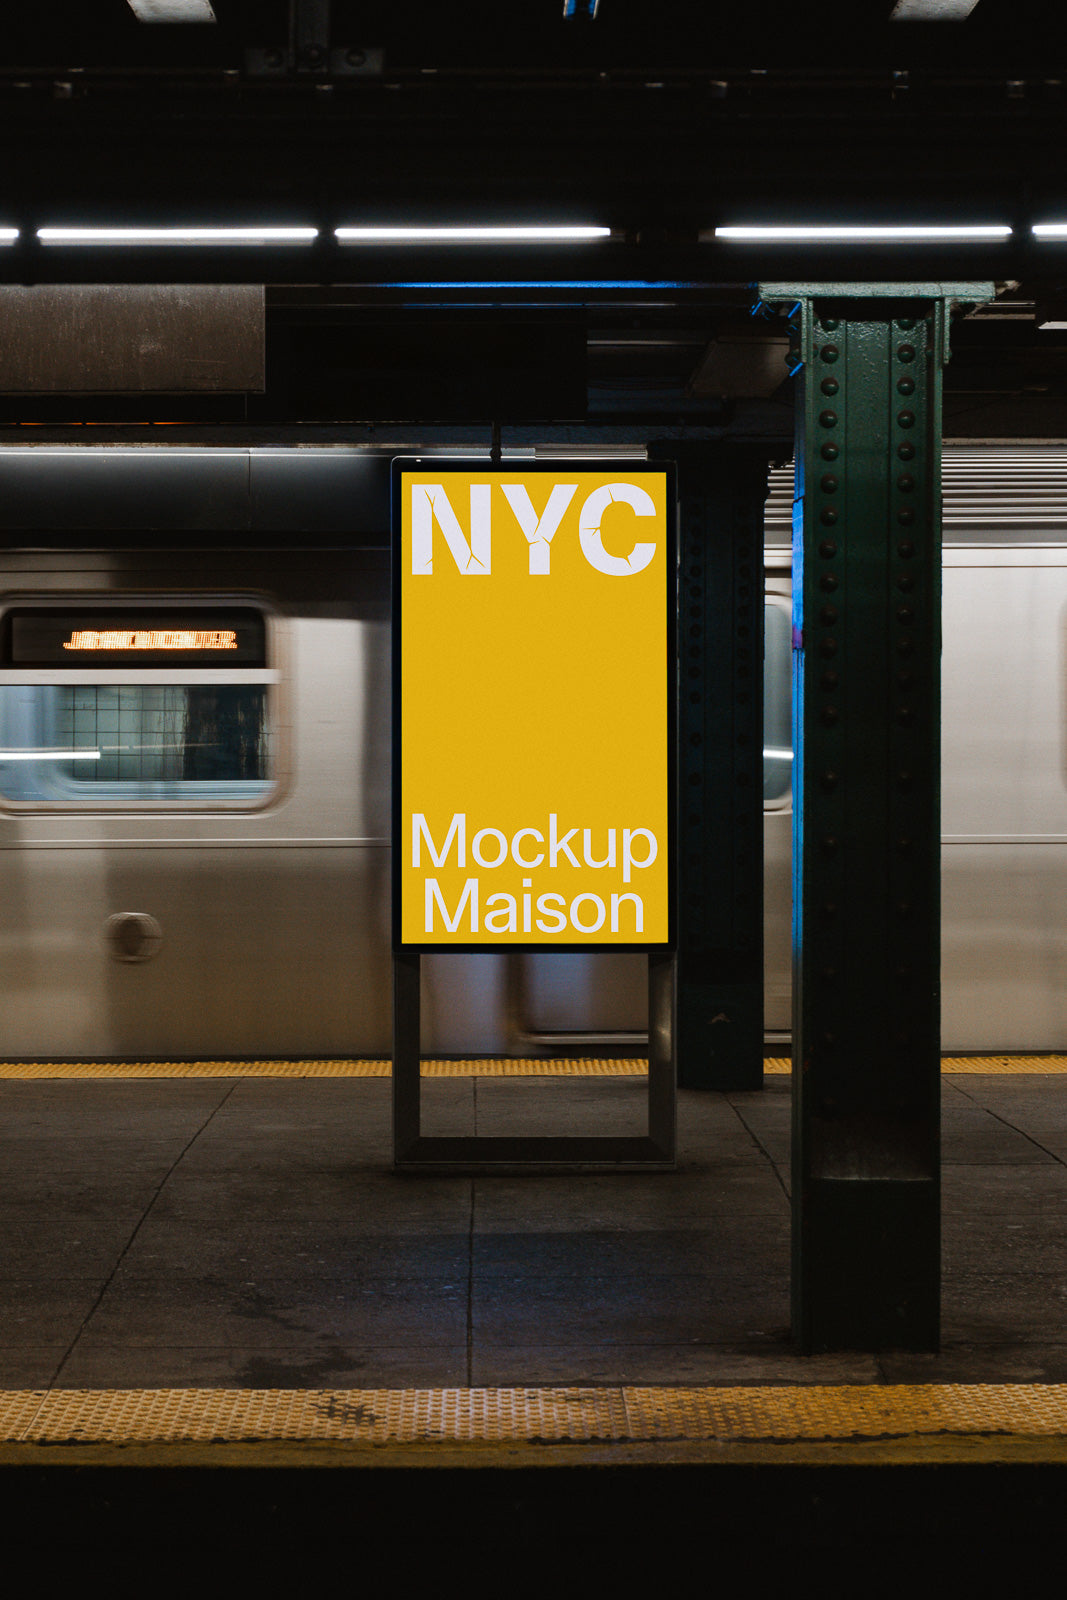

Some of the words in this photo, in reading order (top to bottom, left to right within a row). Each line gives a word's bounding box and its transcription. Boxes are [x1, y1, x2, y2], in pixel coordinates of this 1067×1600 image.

[411, 482, 657, 577] NYC
[411, 813, 658, 883] Mockup
[424, 878, 644, 933] Maison
